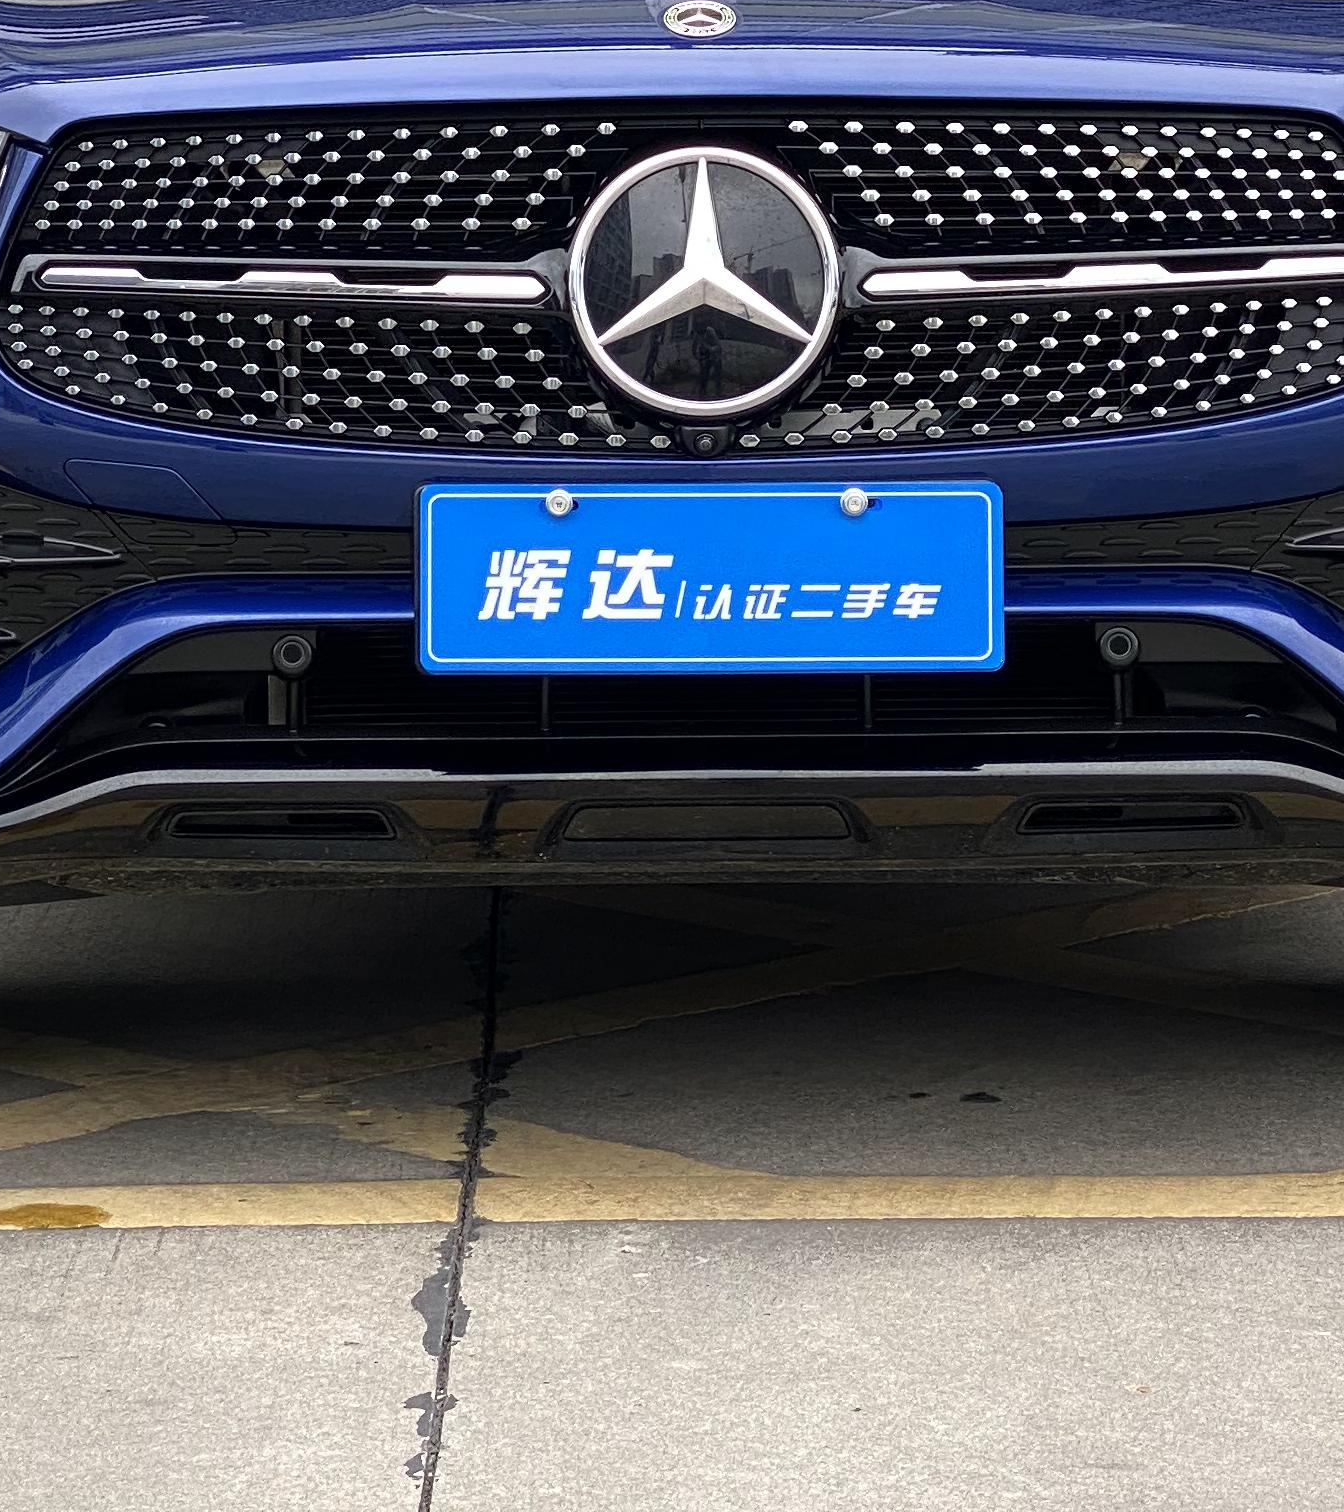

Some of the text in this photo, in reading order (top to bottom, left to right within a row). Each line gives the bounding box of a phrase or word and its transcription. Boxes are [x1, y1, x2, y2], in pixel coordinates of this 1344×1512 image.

[478, 549, 942, 621] 辉达 认证二手车
